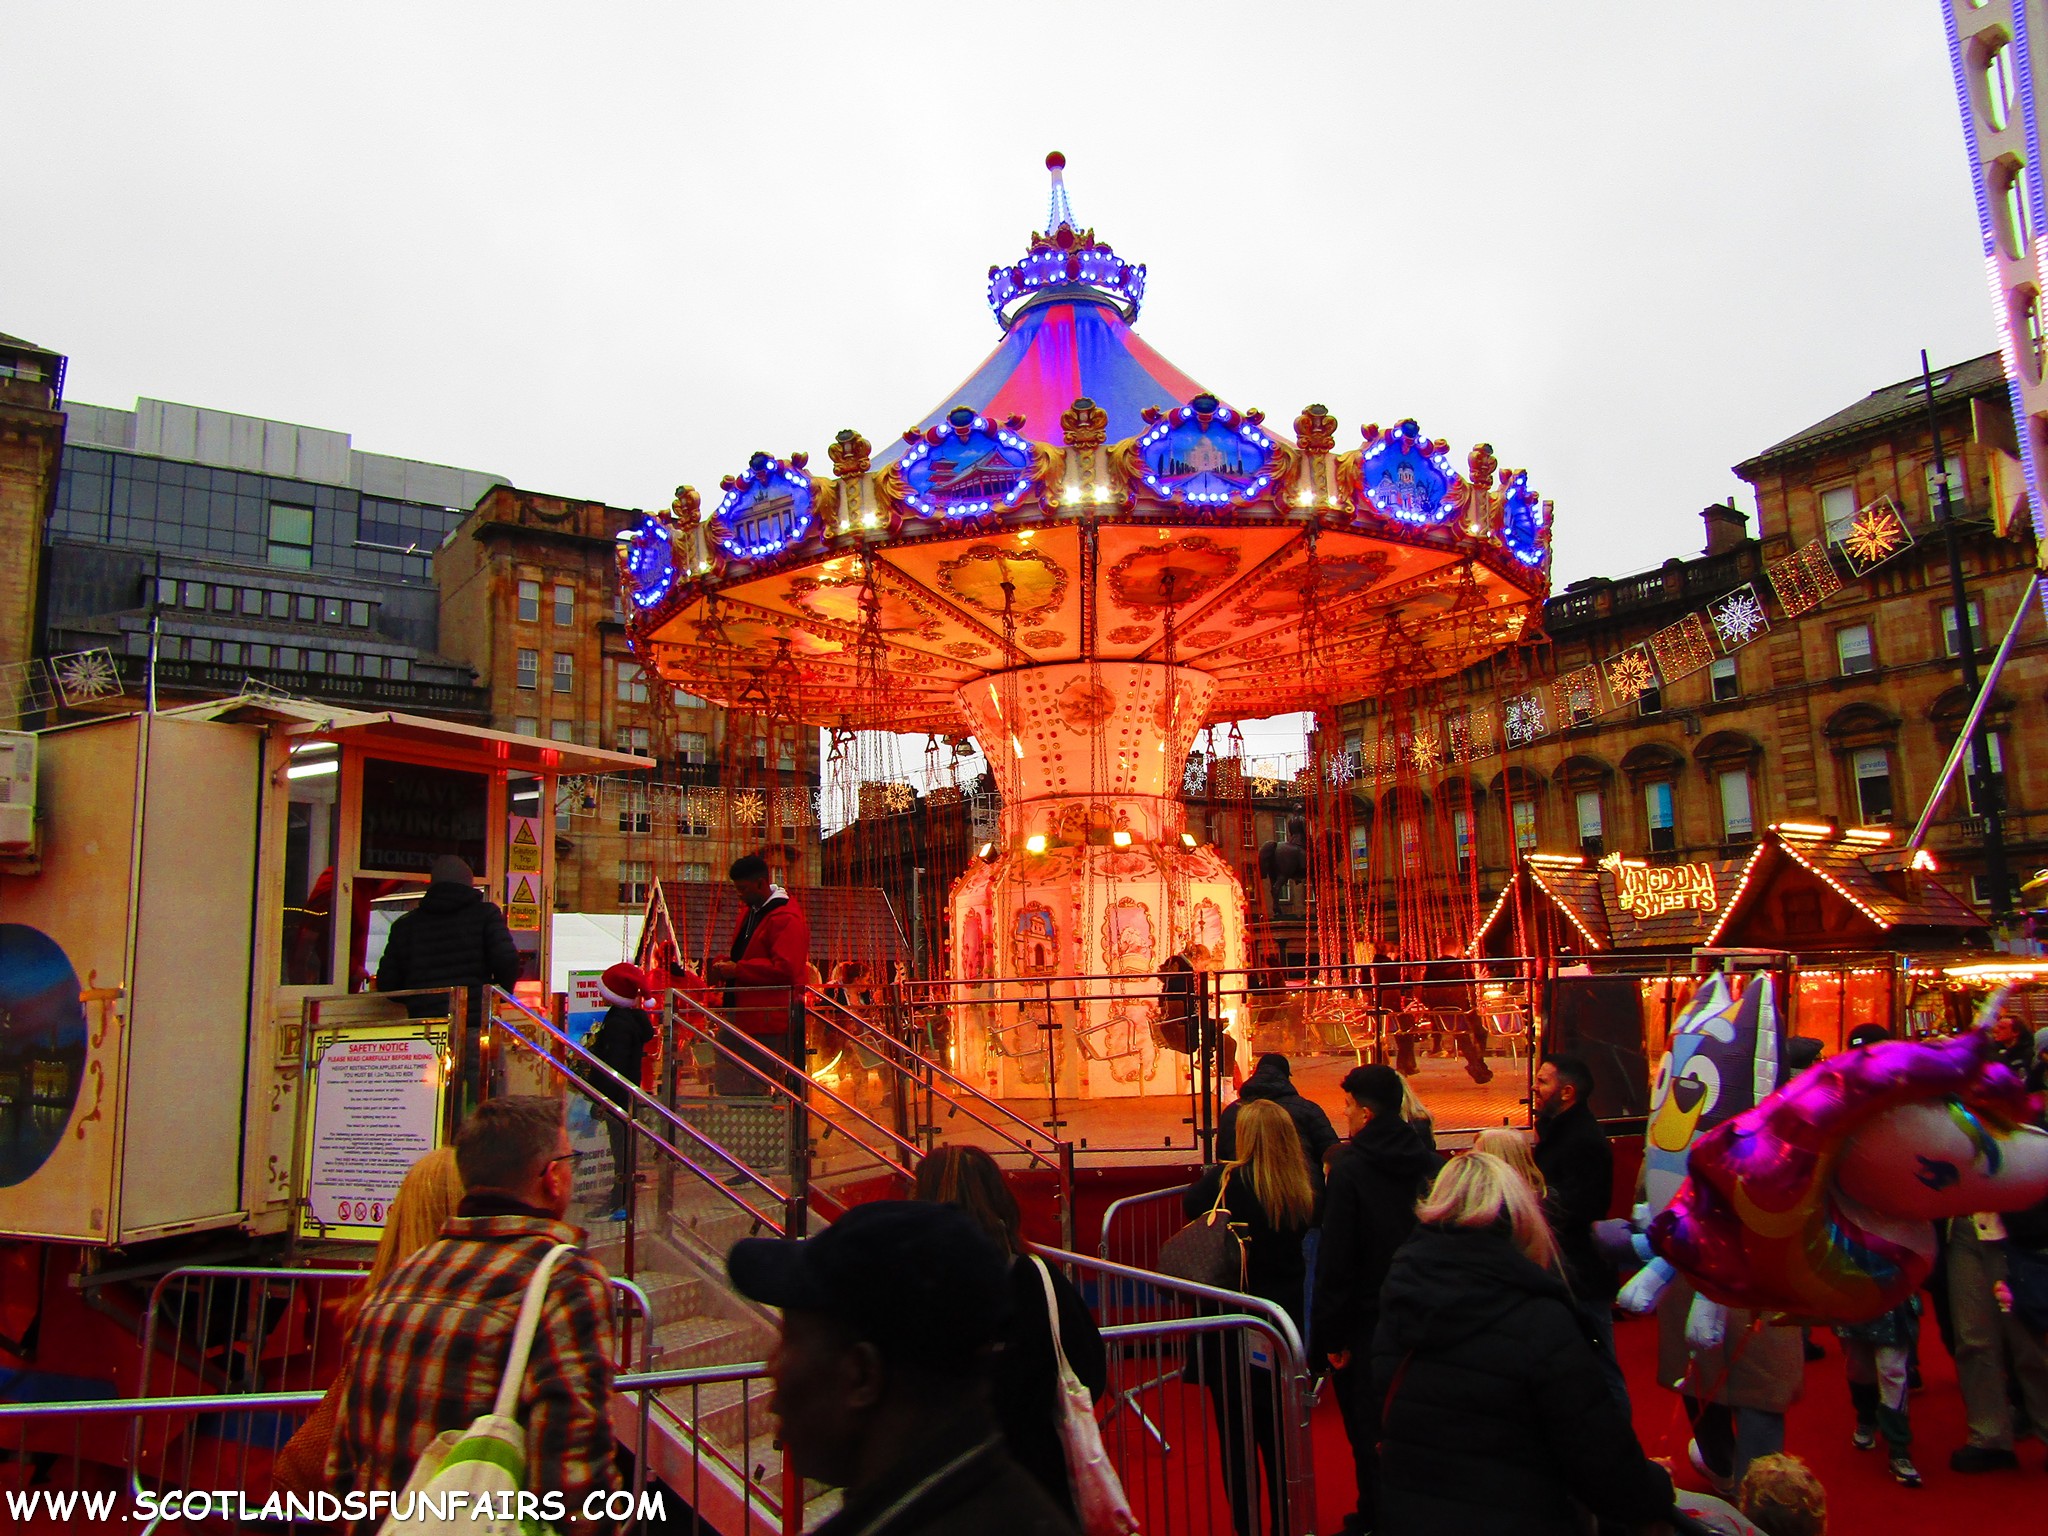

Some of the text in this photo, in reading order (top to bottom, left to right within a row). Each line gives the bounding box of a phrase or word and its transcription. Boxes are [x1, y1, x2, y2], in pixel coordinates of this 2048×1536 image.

[1859, 761, 1887, 769] arvato
[513, 846, 537, 855] Caution
[366, 848, 434, 868] TICKETS
[519, 856, 532, 864] Trip
[1612, 858, 1716, 896] KINGDOM
[1618, 889, 1718, 920] OF SWEETS
[510, 906, 537, 915] Caution
[576, 991, 589, 999] THAN
[590, 990, 599, 998] THE
[349, 1042, 409, 1053] SAFETY NOTICE
